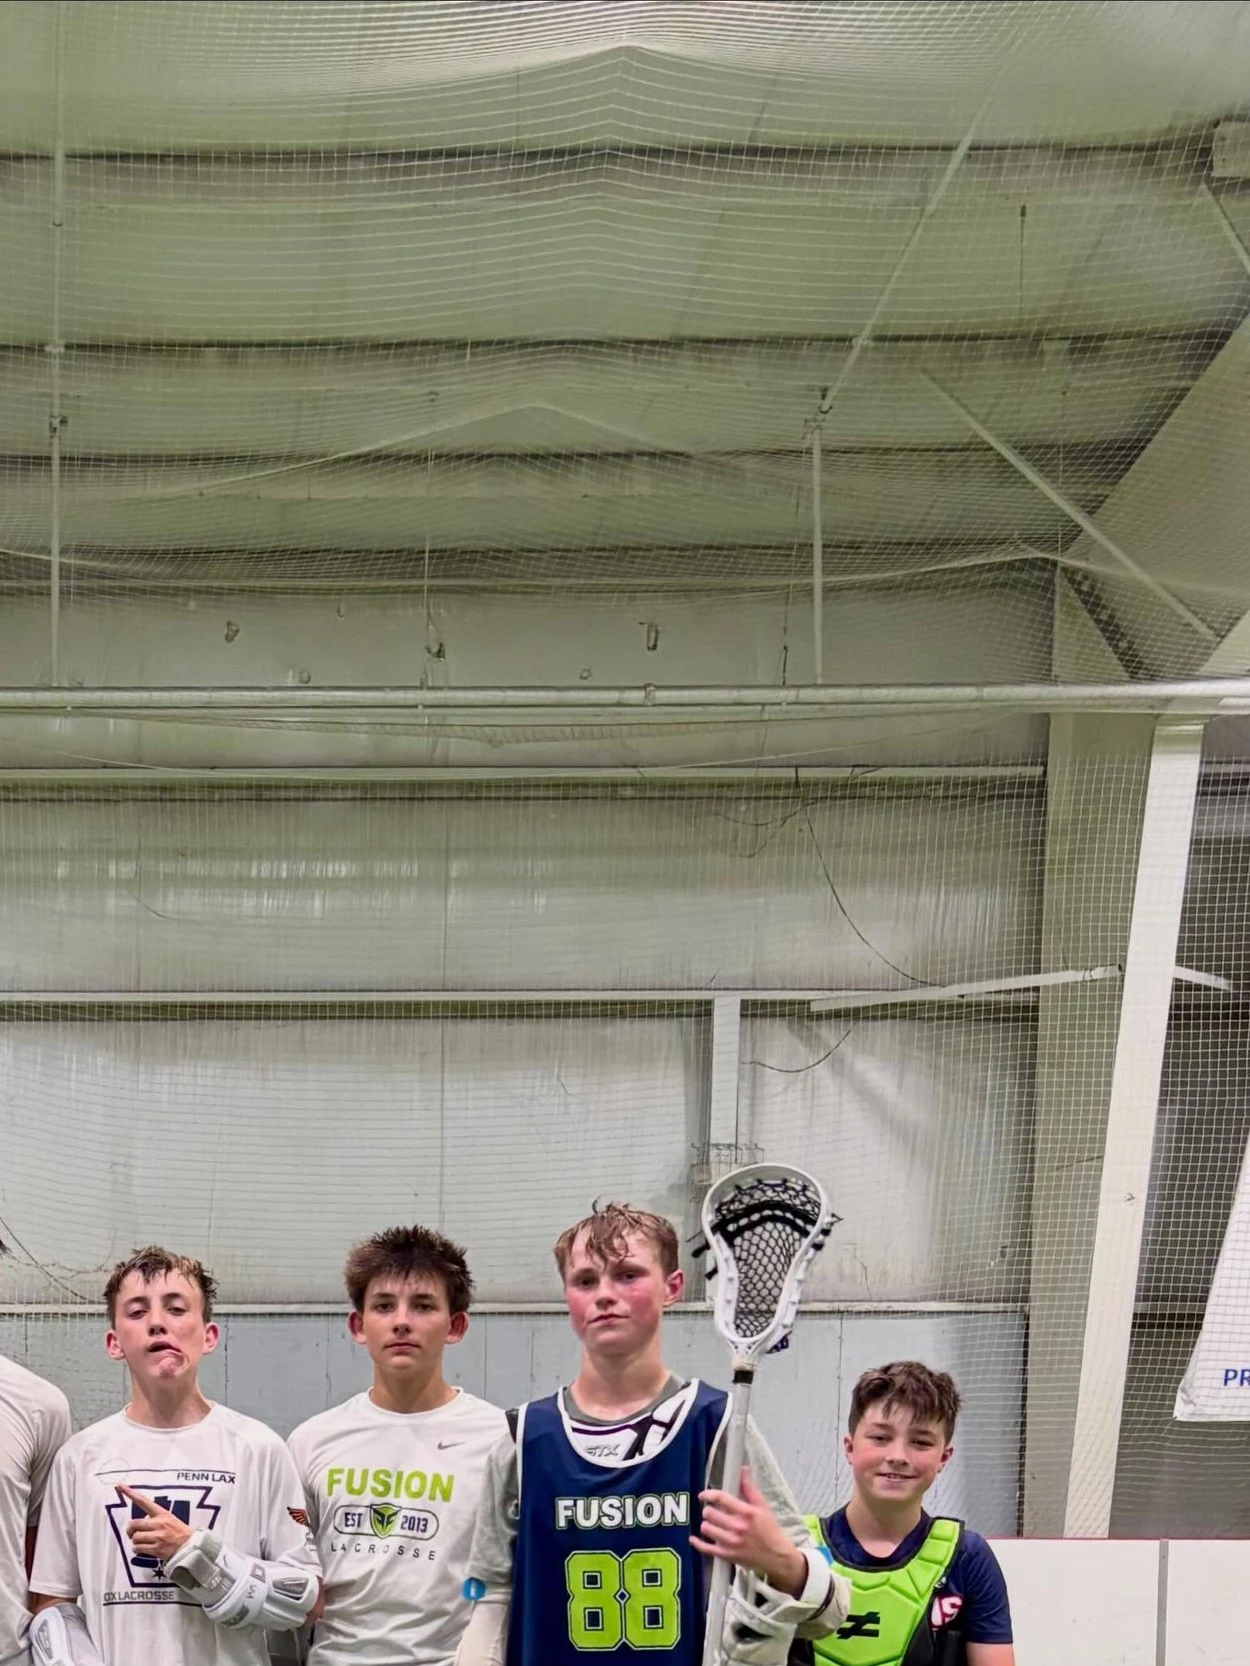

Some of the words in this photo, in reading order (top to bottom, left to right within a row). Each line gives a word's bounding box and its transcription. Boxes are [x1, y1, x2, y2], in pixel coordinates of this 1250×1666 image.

[177, 1472, 209, 1481] PENN
[211, 1474, 236, 1484] LAX
[327, 1467, 455, 1503] FUSION
[556, 1492, 690, 1529] FUSION
[344, 1512, 363, 1528] EST
[400, 1514, 429, 1533] 2013
[330, 1542, 437, 1561] LACROSSE
[118, 1590, 175, 1600] LACROSSE
[565, 1548, 682, 1651] 88
